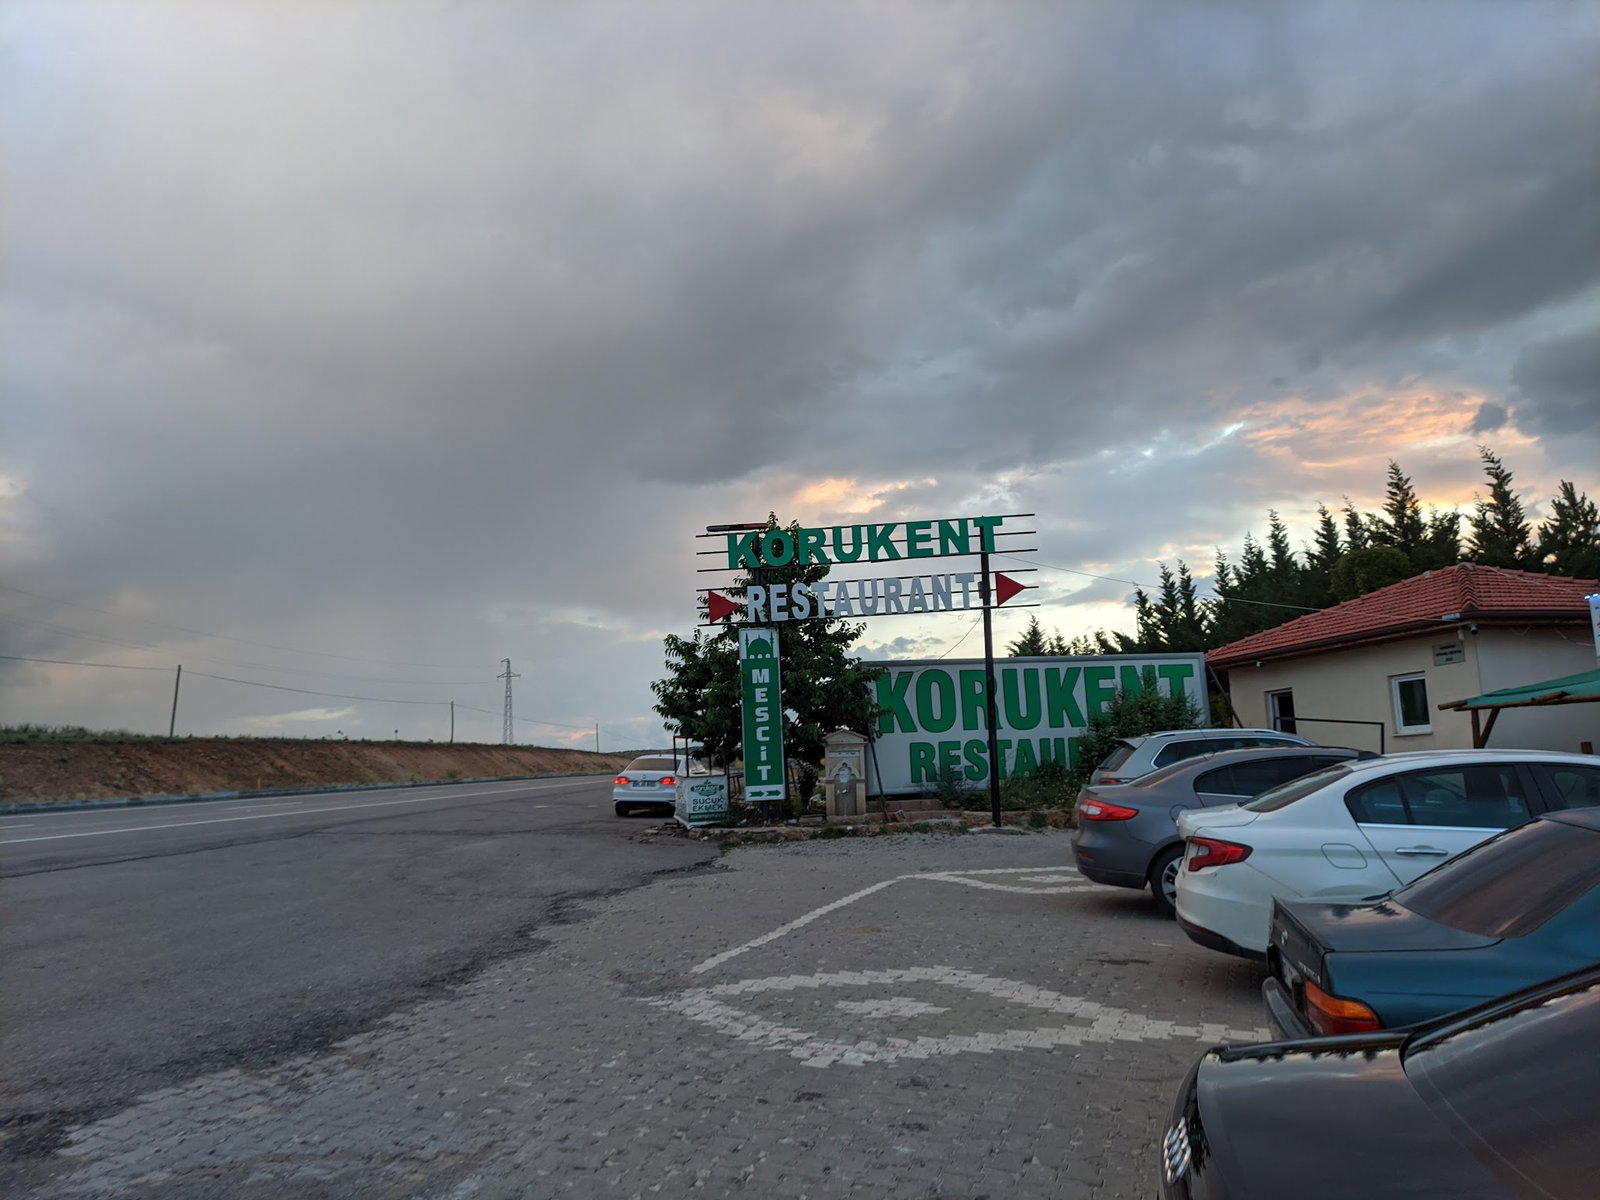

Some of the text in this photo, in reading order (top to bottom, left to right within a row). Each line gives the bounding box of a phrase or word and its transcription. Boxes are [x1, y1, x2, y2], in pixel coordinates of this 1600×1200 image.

[727, 516, 1003, 569] KORUKENT
[747, 572, 975, 624] RESTAURANT
[876, 664, 1194, 733] KORUKENT
[910, 739, 1081, 784] RESTAU
[692, 797, 724, 805] SUCUK
[692, 804, 724, 812] EKMEK
